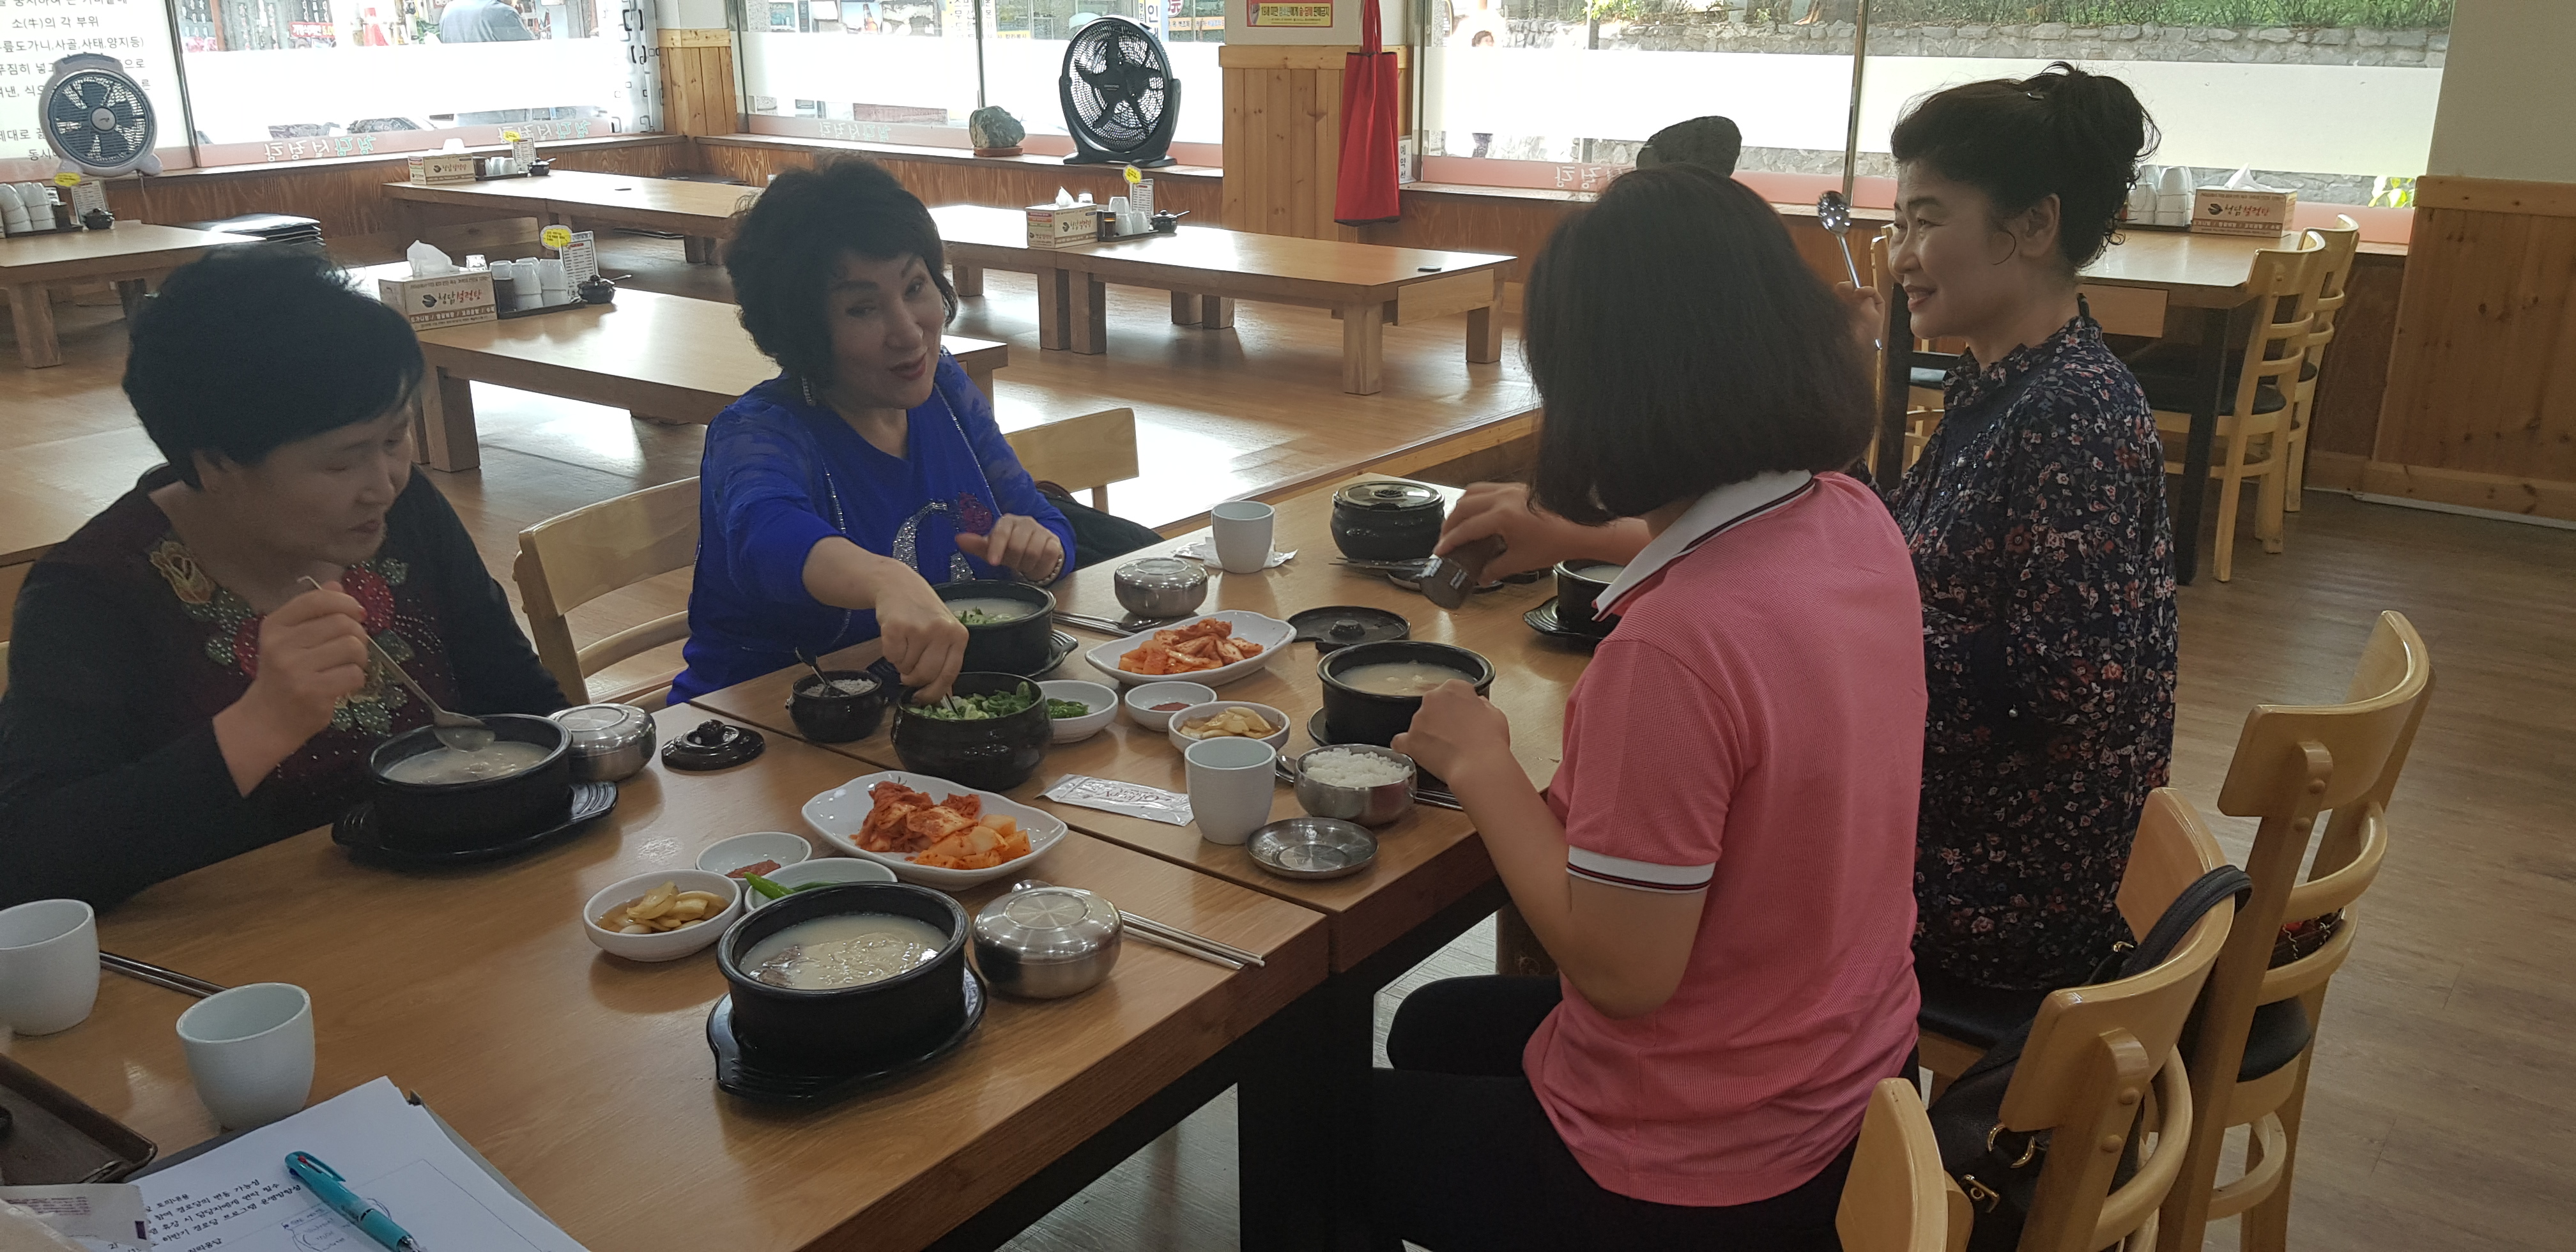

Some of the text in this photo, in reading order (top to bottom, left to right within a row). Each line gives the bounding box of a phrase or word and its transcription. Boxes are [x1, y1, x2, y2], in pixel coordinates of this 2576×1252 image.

[61, 17, 71, 28] 각
[77, 16, 98, 27] 부위
[120, 59, 146, 69] 으로
[234, 1179, 260, 1192] 가능성
[195, 1198, 240, 1218] 담당자에게
[242, 1191, 260, 1200] 연락
[263, 1183, 280, 1193] 필수
[193, 1218, 218, 1232] 경로당
[224, 1203, 257, 1221] 프로그램
